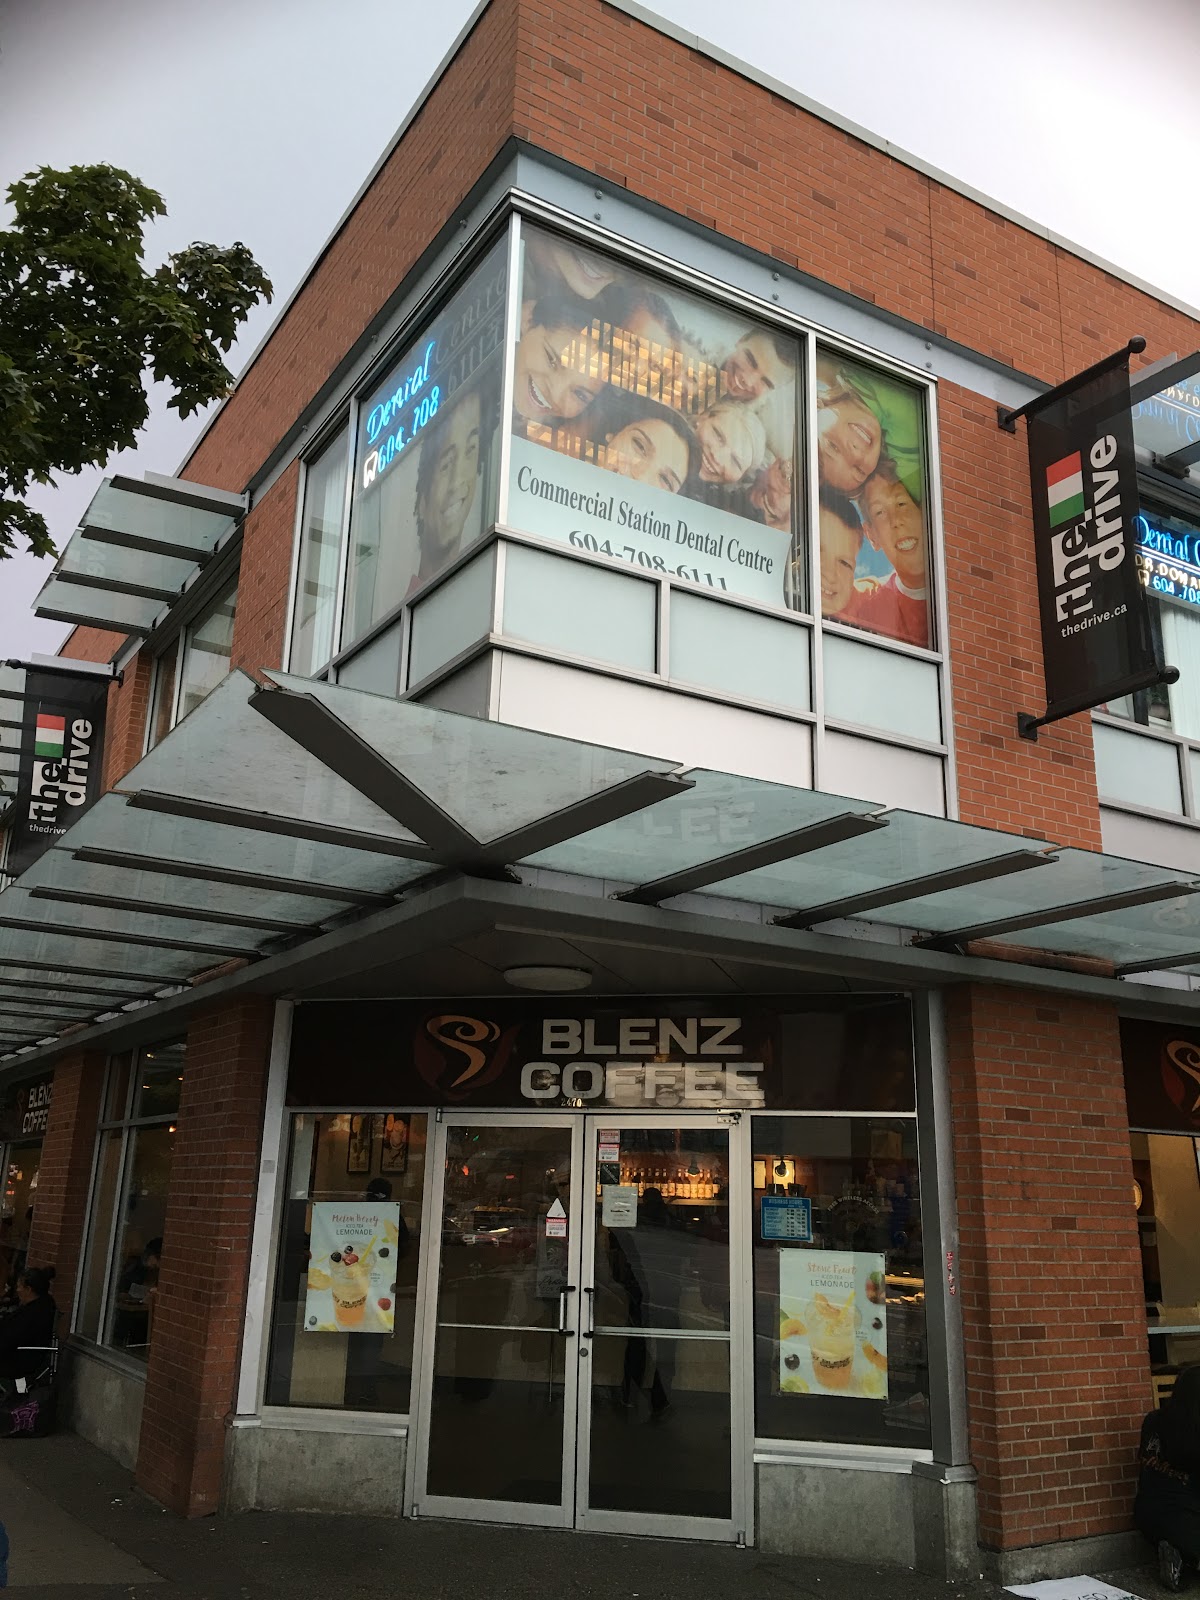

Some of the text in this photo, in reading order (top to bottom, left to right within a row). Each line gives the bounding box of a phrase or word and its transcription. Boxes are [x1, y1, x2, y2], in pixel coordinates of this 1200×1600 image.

[517, 465, 774, 575] Commercial Station Dental Centre
[1085, 433, 1127, 571] drive
[1131, 516, 1191, 563] Dental
[1061, 603, 1128, 638] thedrive.ca
[60, 718, 93, 807] drive
[542, 1017, 744, 1055] BLENZ
[28, 1082, 54, 1109] BLENZ
[520, 1061, 765, 1100] COFFEE
[560, 1097, 583, 1108] 2470
[22, 1108, 49, 1134] COFFE
[335, 1228, 373, 1236] LEMONADE
[810, 1279, 855, 1289] LEMONADE
